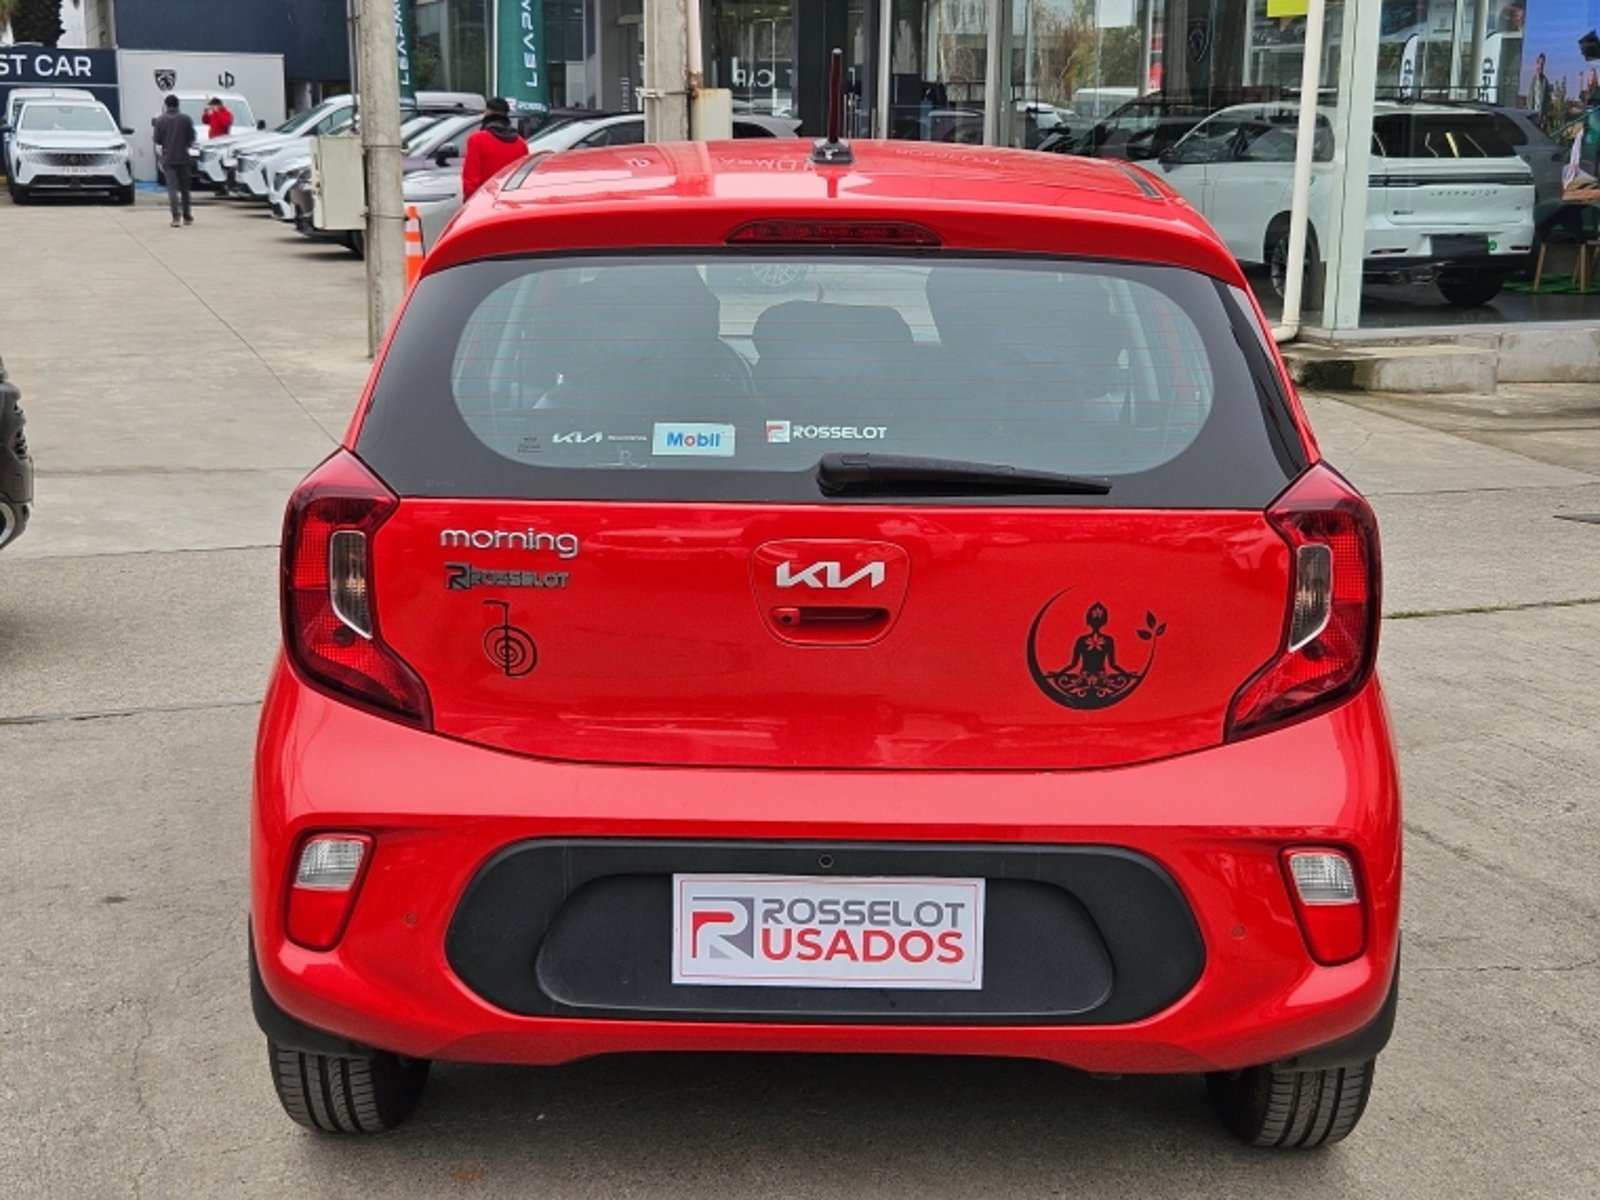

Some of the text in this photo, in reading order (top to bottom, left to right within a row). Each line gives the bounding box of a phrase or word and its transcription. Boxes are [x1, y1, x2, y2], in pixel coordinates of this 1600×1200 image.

[34, 54, 92, 77] CAR
[666, 432, 723, 449] Mobil
[792, 424, 888, 441] ROSSELOT
[439, 528, 580, 560] morning
[471, 568, 571, 589] ROSSELOT
[776, 561, 886, 590] KIA
[762, 898, 966, 929] ROSSELOT
[762, 927, 966, 964] USADOS
